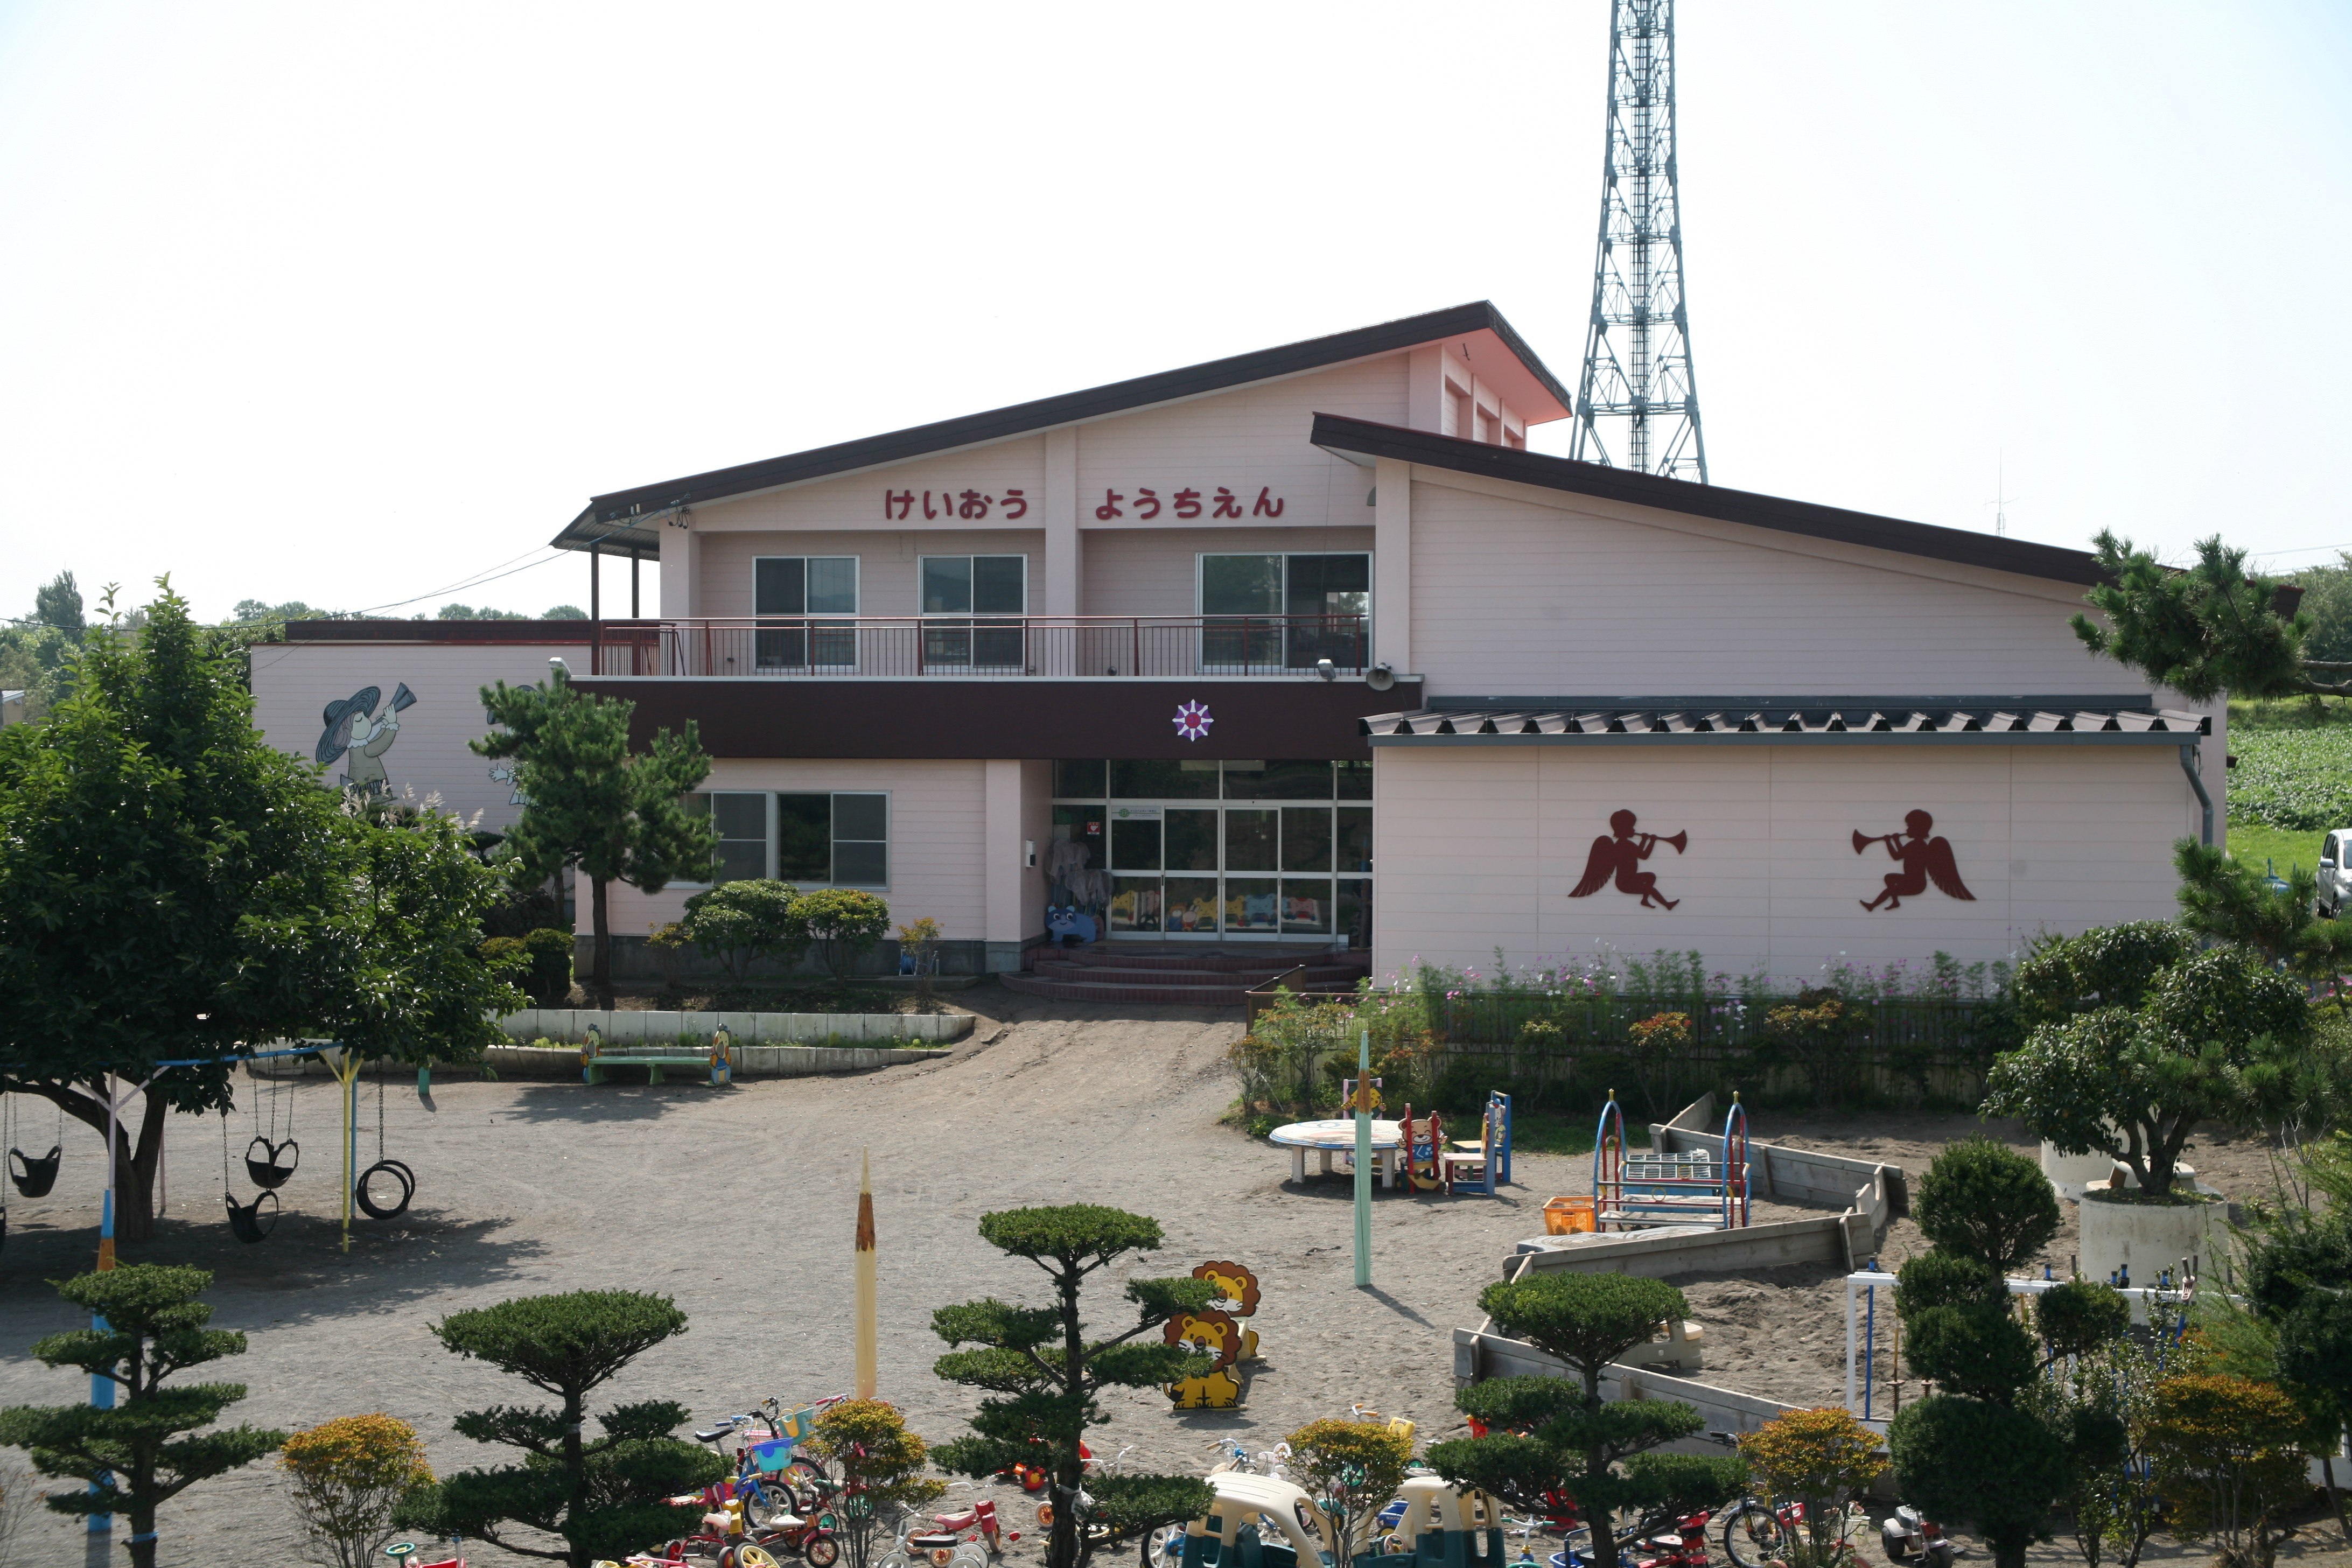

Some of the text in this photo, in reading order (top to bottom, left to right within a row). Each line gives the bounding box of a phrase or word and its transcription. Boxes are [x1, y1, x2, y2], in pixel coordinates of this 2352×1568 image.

[885, 487, 1283, 520] けいおう ようちえん
